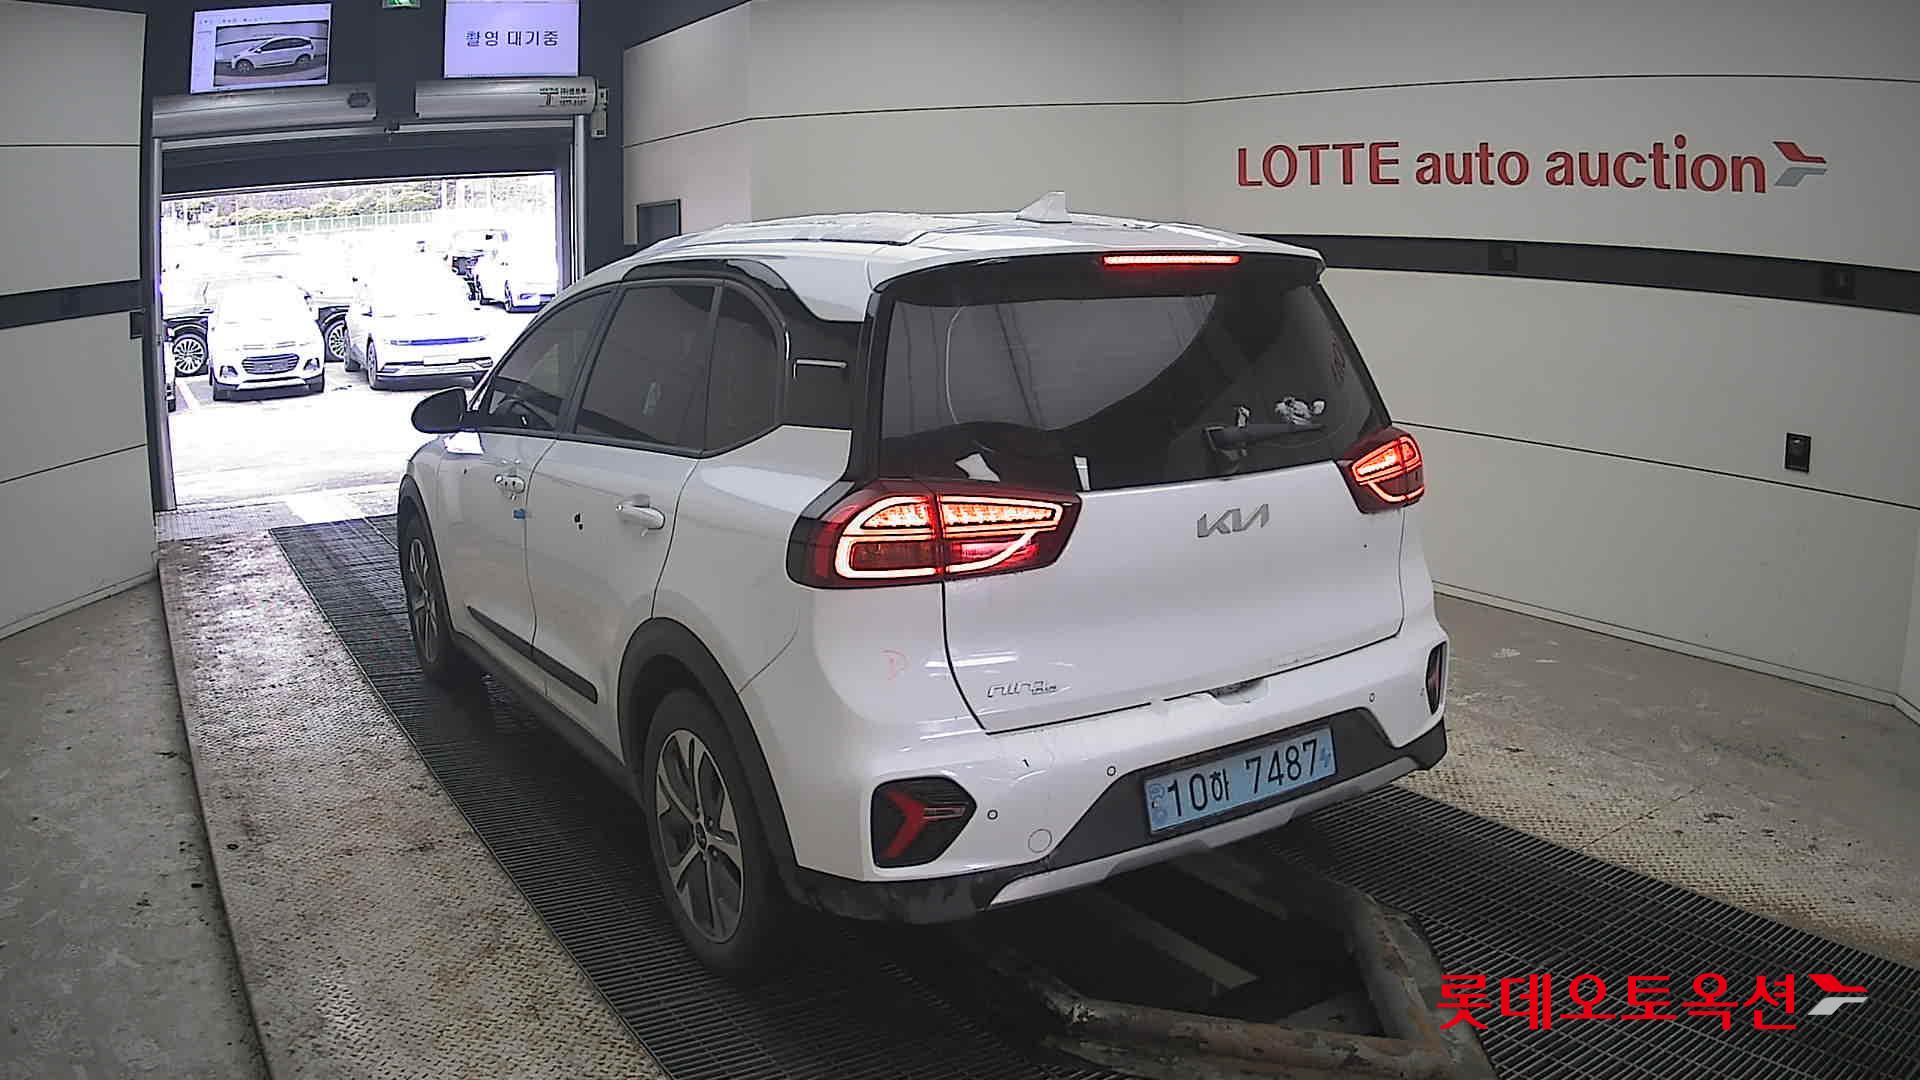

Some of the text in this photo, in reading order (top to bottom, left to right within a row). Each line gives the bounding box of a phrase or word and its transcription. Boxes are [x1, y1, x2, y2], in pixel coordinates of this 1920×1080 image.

[507, 31, 559, 46] 대기중
[1237, 134, 1767, 193] LOTTE auto auction
[1197, 503, 1270, 538] KIA
[1168, 738, 1318, 817] 10하 7487
